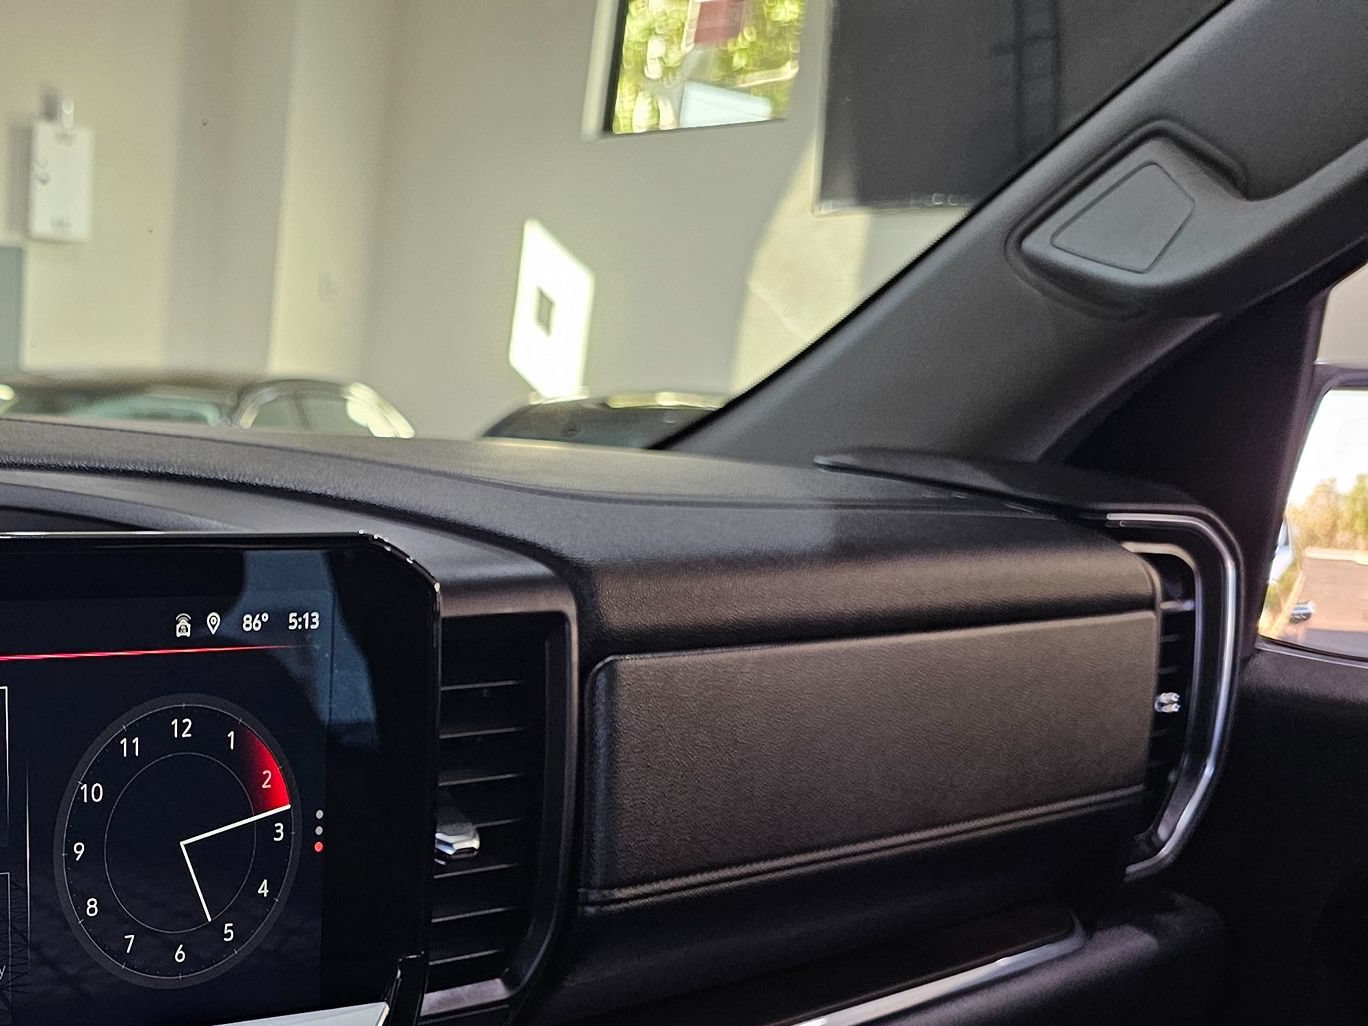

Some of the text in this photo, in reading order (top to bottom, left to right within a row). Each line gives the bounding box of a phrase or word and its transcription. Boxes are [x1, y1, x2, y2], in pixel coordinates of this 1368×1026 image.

[288, 611, 320, 630] 5:13
[171, 717, 193, 739] 12
[119, 736, 139, 758] 11
[227, 730, 235, 750] 1
[259, 768, 273, 790] 2
[79, 782, 104, 803] 10
[273, 822, 284, 842] 3
[73, 841, 85, 862] 9
[257, 878, 269, 898] 4
[86, 897, 99, 917] 8
[223, 922, 234, 942] 5
[124, 934, 135, 954] 7
[174, 944, 186, 963] 6
